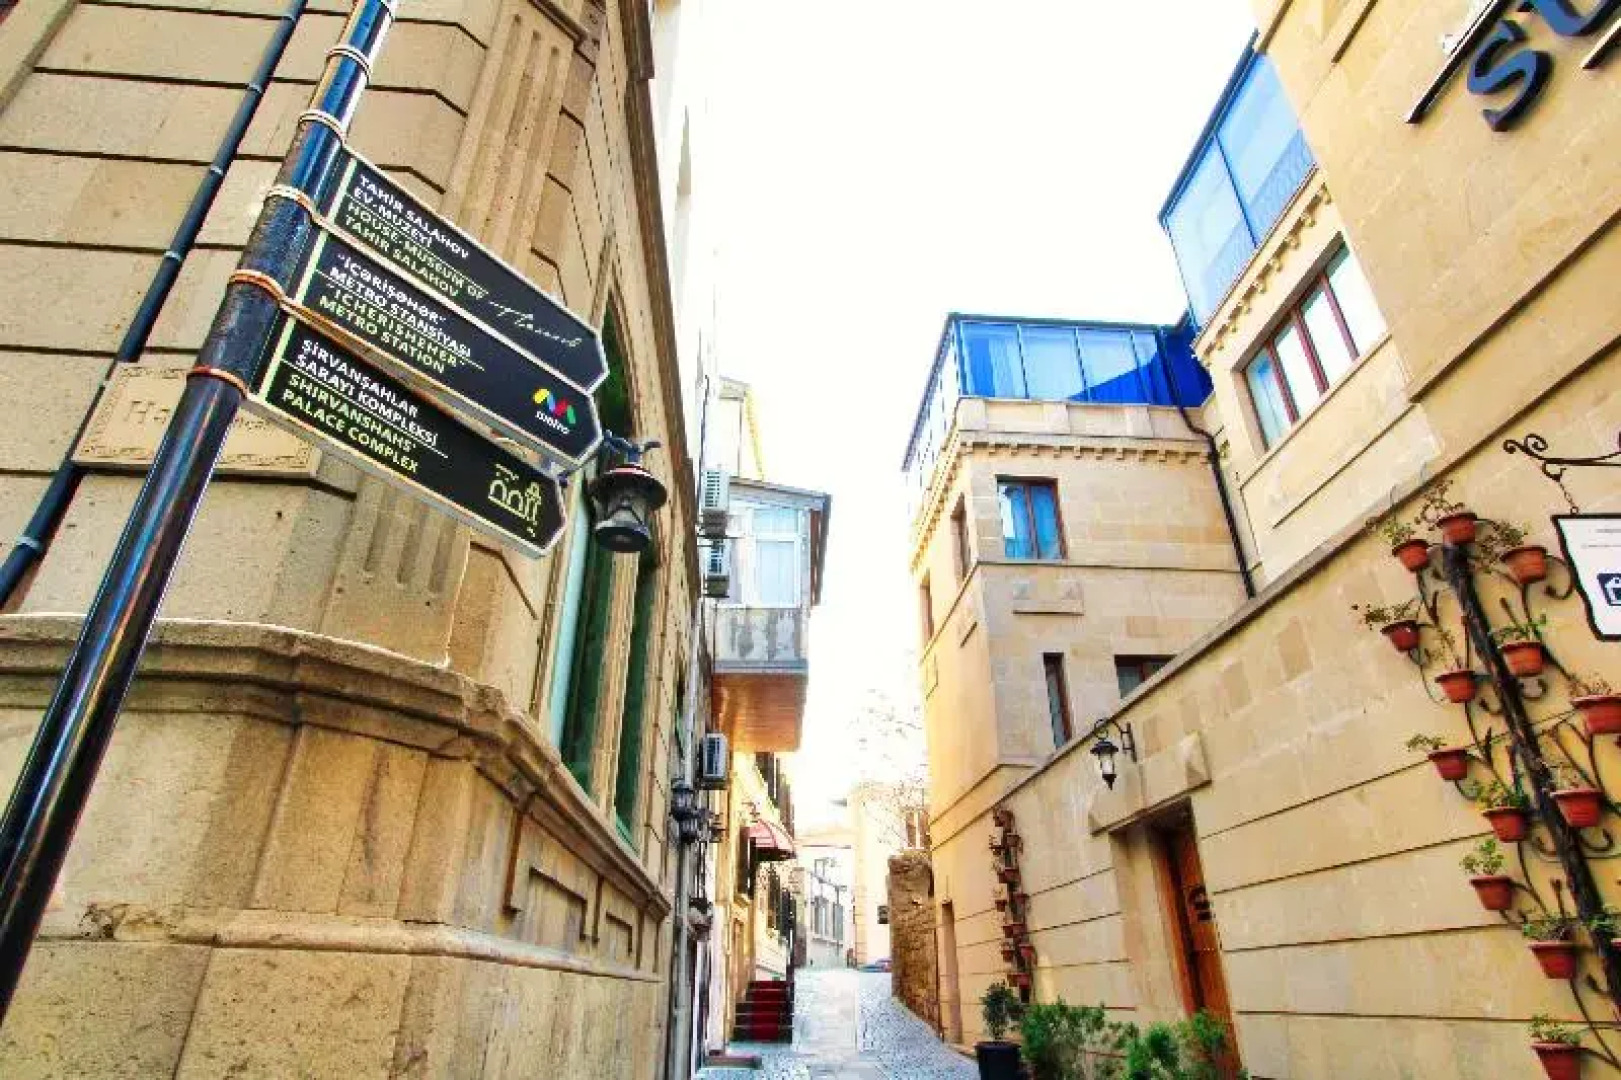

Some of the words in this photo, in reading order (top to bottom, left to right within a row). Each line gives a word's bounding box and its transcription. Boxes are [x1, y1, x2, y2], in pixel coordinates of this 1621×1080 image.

[405, 210, 469, 258] SALAHOV
[329, 266, 387, 306] METRO
[393, 249, 458, 297] SALAHOV
[467, 286, 485, 299] OF
[320, 295, 377, 334] METRO
[381, 331, 445, 373] STATION
[282, 388, 345, 432] PALACE
[348, 427, 419, 473] COMPLEX
